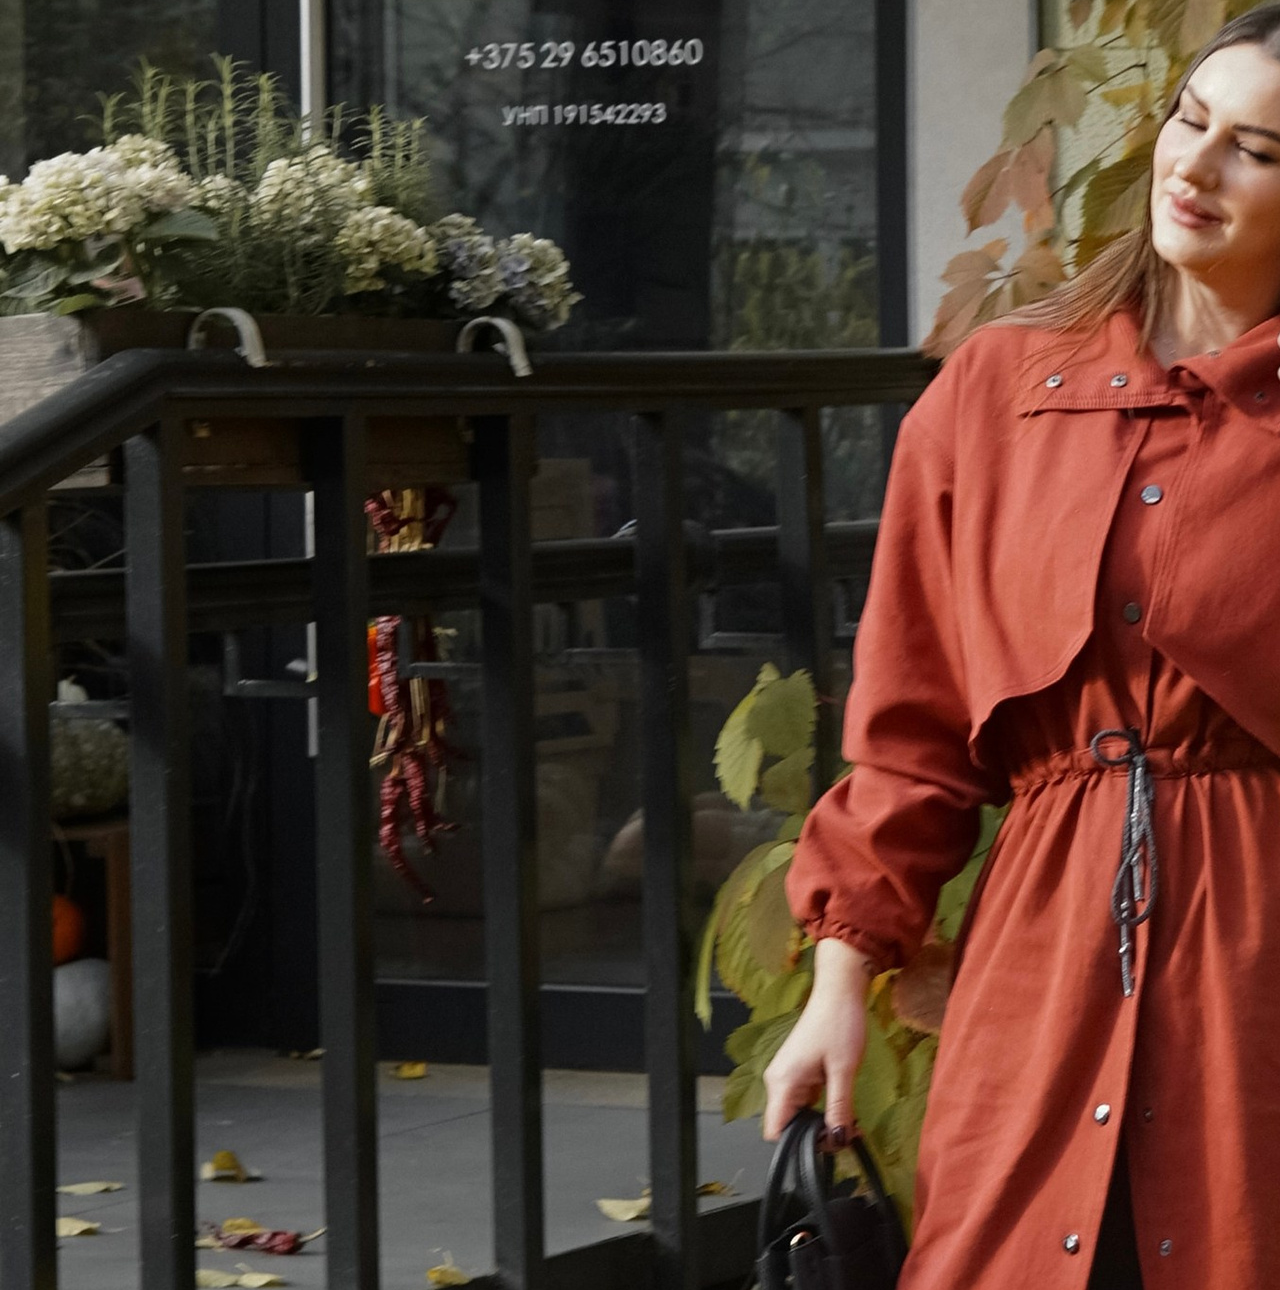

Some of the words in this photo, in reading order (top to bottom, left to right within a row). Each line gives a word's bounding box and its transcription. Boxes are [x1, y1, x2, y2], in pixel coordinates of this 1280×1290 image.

[465, 42, 535, 70] +375
[540, 41, 576, 68] 29
[581, 38, 703, 67] 6510860
[553, 102, 667, 124] 191542293
